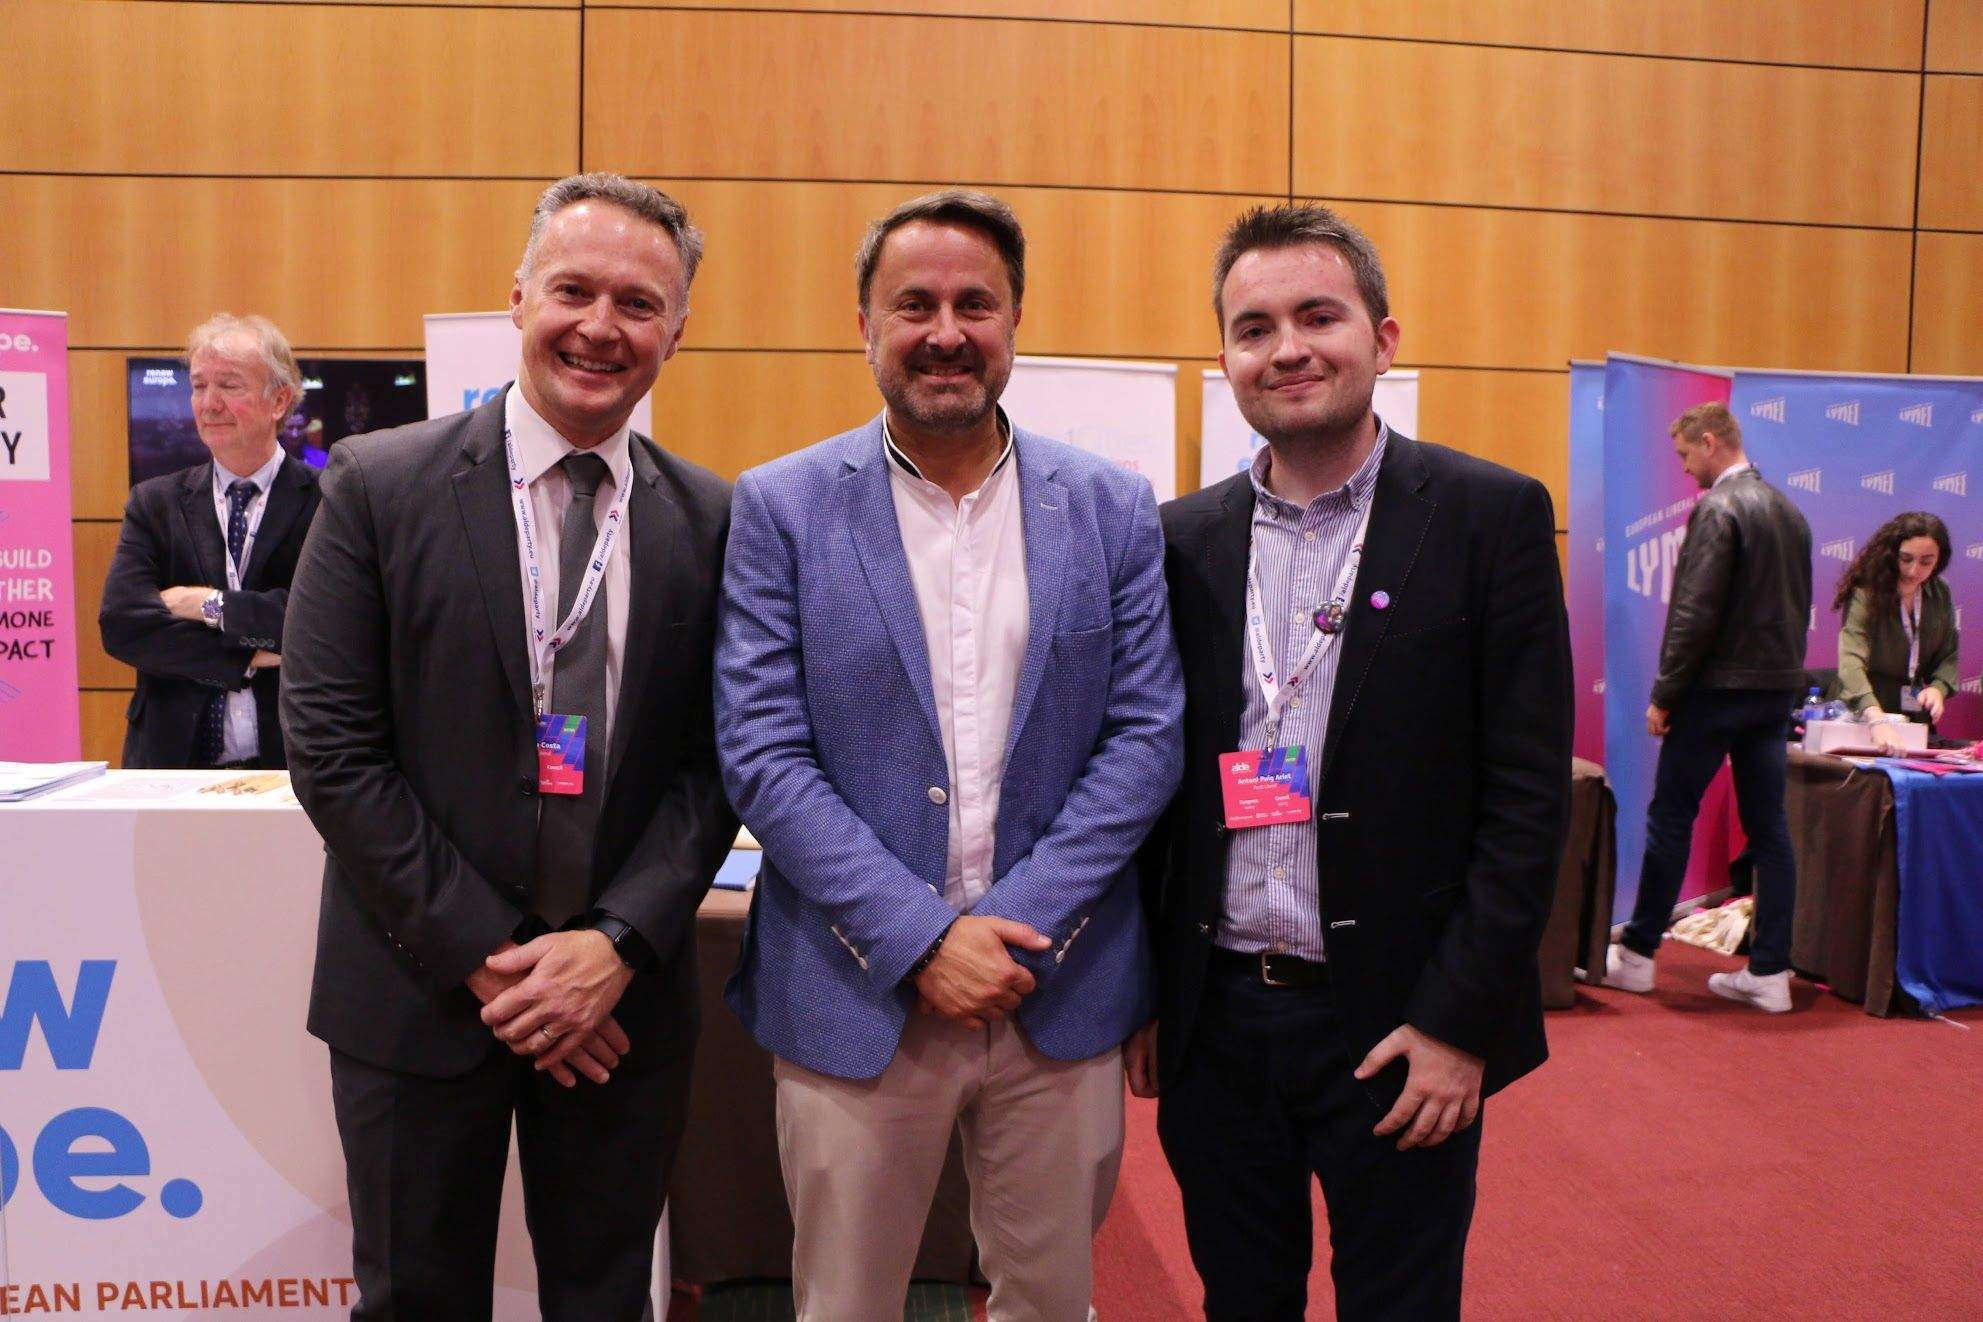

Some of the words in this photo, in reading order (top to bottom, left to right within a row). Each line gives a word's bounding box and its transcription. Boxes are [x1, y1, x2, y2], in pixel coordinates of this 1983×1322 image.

[0, 549, 52, 569] UILD
[0, 1106, 203, 1220] e.
[97, 1278, 354, 1311] PARLIAMENT
